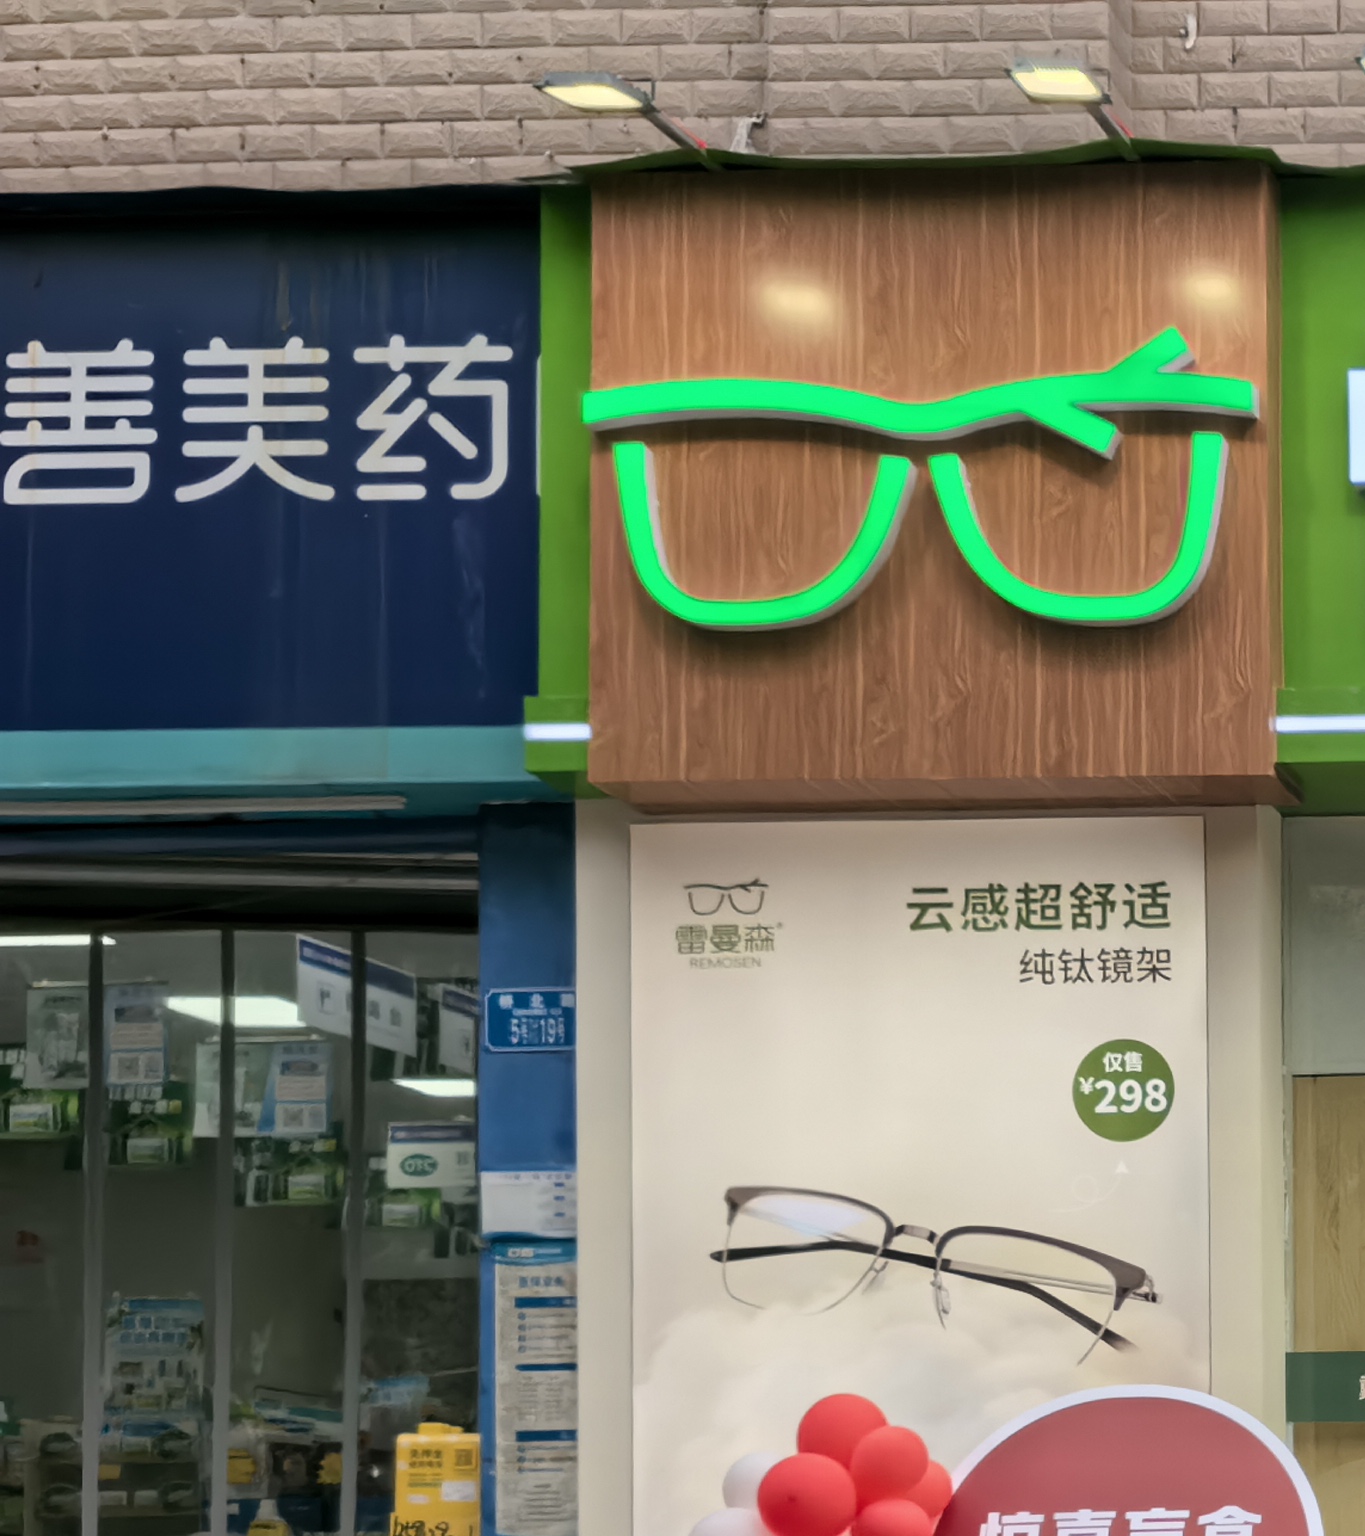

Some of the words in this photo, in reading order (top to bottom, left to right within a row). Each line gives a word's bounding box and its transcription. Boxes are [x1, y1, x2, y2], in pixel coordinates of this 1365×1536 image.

[0, 334, 540, 505] 善美药
[906, 880, 1172, 933] 云感超舒适
[675, 923, 775, 955] 雷曼森
[689, 957, 762, 970] REMOSEN
[1019, 946, 1173, 985] 纯钛镜架
[1103, 1051, 1143, 1072] 仅售
[1078, 1077, 1168, 1113] ¥298
